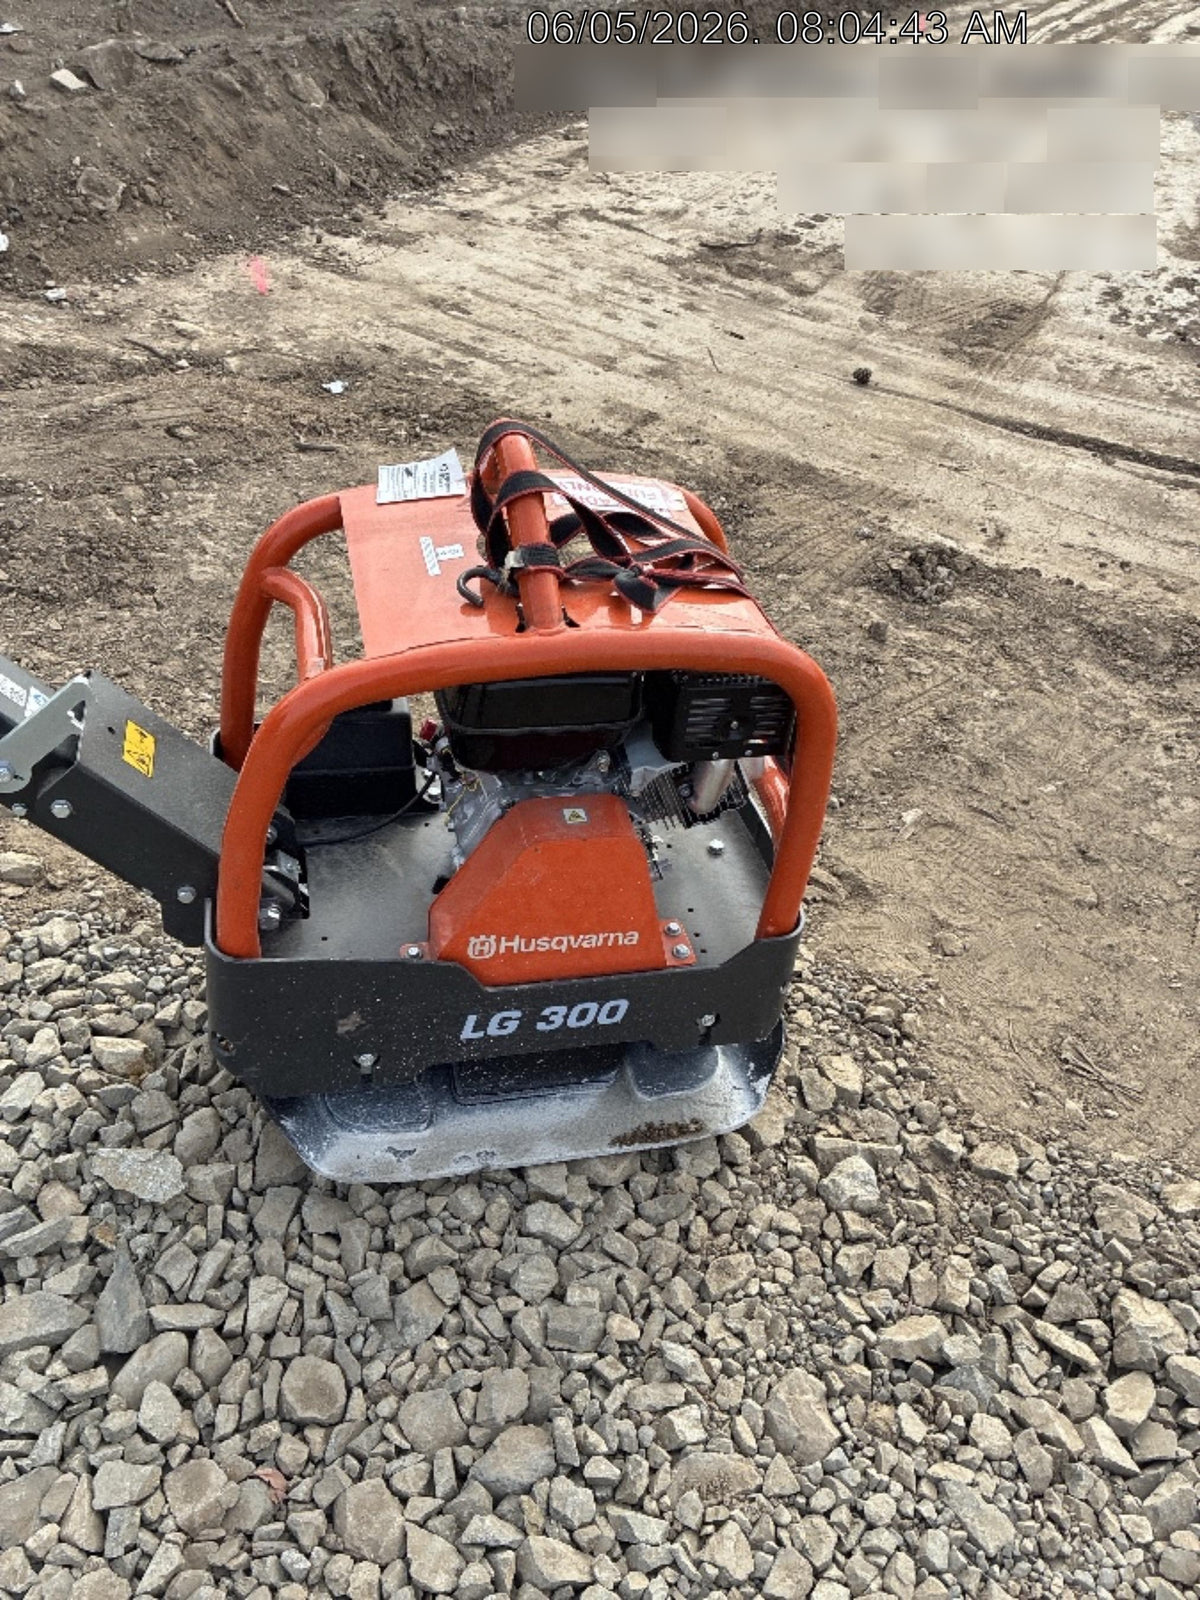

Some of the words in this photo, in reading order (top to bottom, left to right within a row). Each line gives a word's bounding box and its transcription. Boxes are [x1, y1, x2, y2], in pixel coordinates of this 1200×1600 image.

[499, 930, 640, 954] Husqvarna
[459, 1010, 524, 1041] LG
[536, 998, 630, 1032] 300
